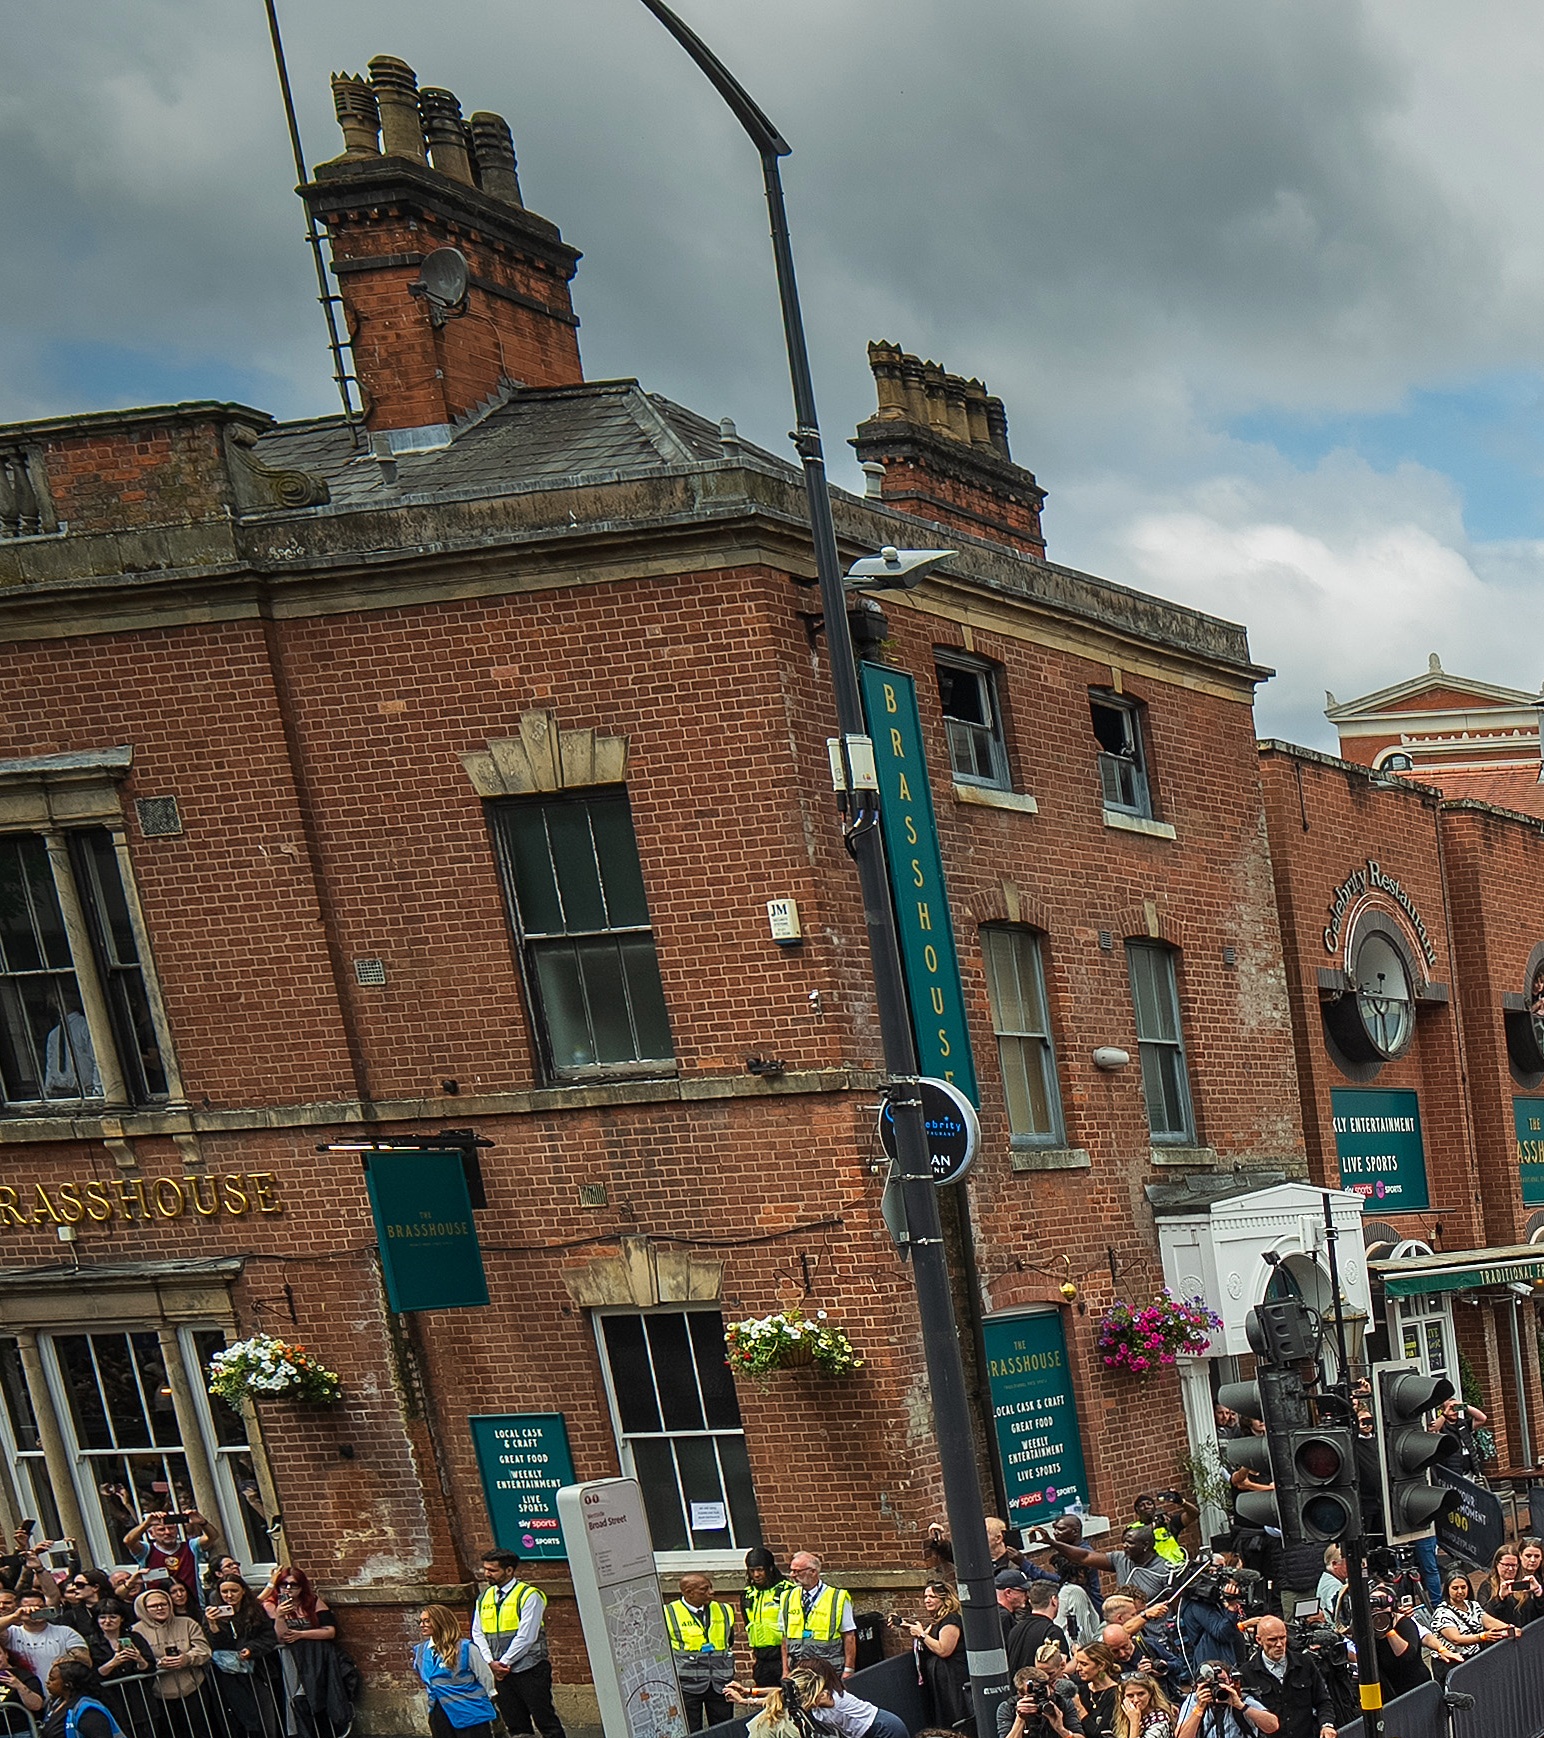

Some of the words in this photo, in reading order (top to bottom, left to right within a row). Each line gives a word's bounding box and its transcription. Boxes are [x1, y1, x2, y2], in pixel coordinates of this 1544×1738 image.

[771, 904, 788, 917] JM
[1323, 867, 1366, 953] Celebrity
[1367, 860, 1436, 966] Restaurant
[1350, 1117, 1414, 1132] ENTERTAINMENT
[1529, 1118, 1540, 1131] THE
[1342, 1156, 1362, 1173] LIVE
[1366, 1155, 1398, 1172] SPORTS
[1384, 1185, 1402, 1193] SPORTS
[387, 1222, 468, 1239] BRASSHOUSE
[1480, 1267, 1534, 1286] TRADITIONAL
[1014, 1340, 1026, 1351] THE
[988, 1350, 1061, 1378] RASSHOUSE
[1017, 1402, 1034, 1414] CASK
[1037, 1401, 1042, 1410] &
[1045, 1395, 1065, 1408] CRAFT
[1011, 1420, 1034, 1434] GREAT
[1036, 1417, 1054, 1429] FOOD
[495, 1429, 520, 1439] LOCAL
[522, 1428, 544, 1438] CASK
[504, 1439, 511, 1448] &
[513, 1438, 538, 1448] CRAFT
[1021, 1436, 1049, 1450] WEEKLY
[499, 1454, 524, 1464] GREAT
[526, 1453, 549, 1463] FOOD
[1008, 1443, 1064, 1465] ENTERTAINMENT
[510, 1469, 543, 1479] WEEKLY
[1017, 1468, 1035, 1482] LIVE
[1036, 1463, 1062, 1478] SPORTS
[497, 1478, 562, 1489] ENTERTAINMENT
[522, 1494, 542, 1504] LIVE
[1009, 1498, 1020, 1510] sky
[1021, 1493, 1042, 1506] sports
[1057, 1485, 1078, 1497] SPORTS
[518, 1503, 550, 1512] SPORTS
[518, 1519, 531, 1529] sky
[531, 1519, 557, 1529] sports
[589, 1518, 608, 1531] Broad
[608, 1514, 628, 1527] Street
[535, 1538, 561, 1546] SPORTS
